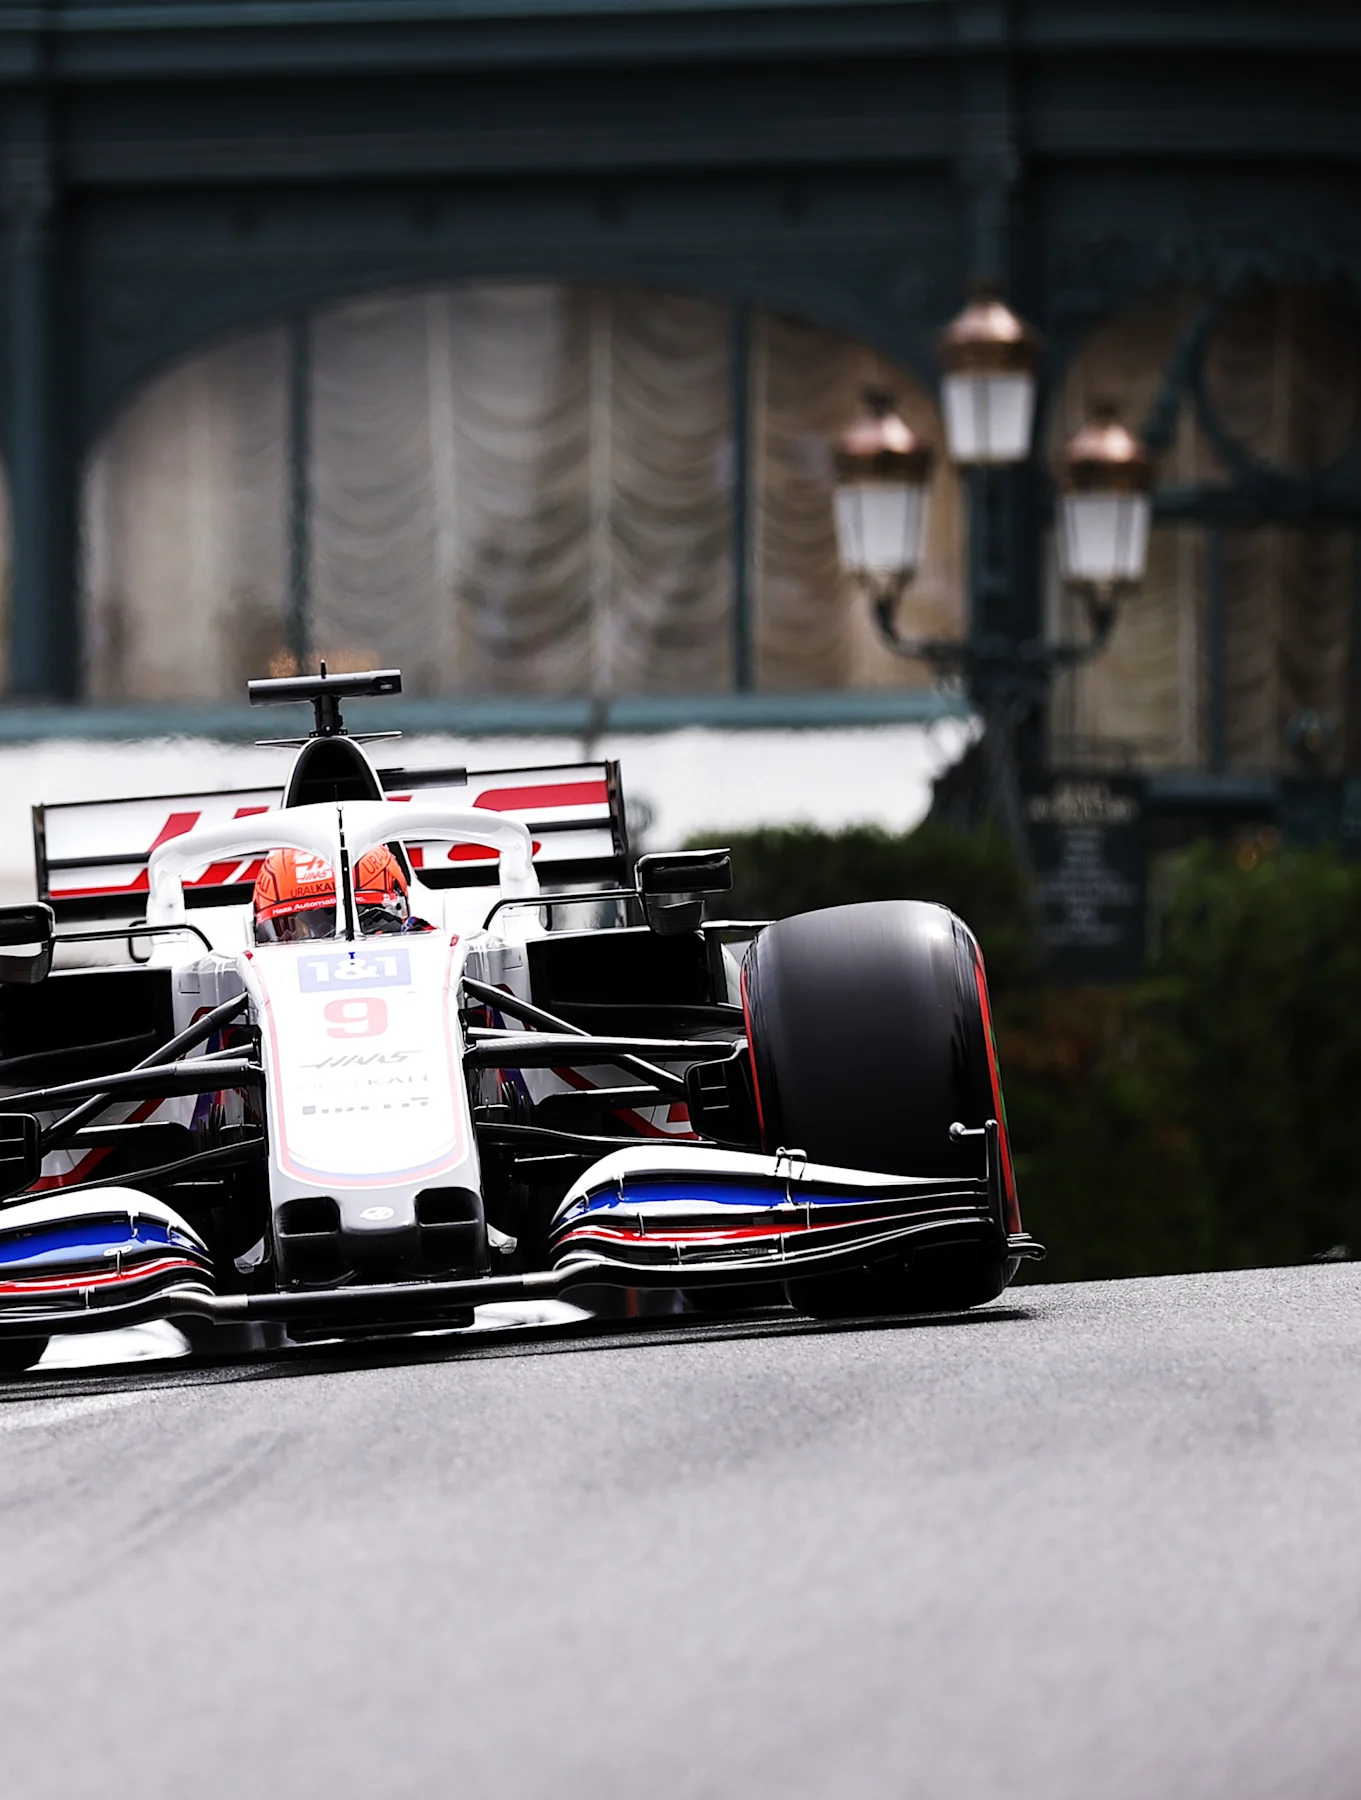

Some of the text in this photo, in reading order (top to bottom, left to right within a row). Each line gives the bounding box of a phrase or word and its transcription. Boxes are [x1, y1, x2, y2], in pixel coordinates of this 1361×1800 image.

[306, 955, 398, 983] 1&1
[323, 996, 389, 1039] 9
[298, 1050, 423, 1069] HAAS
